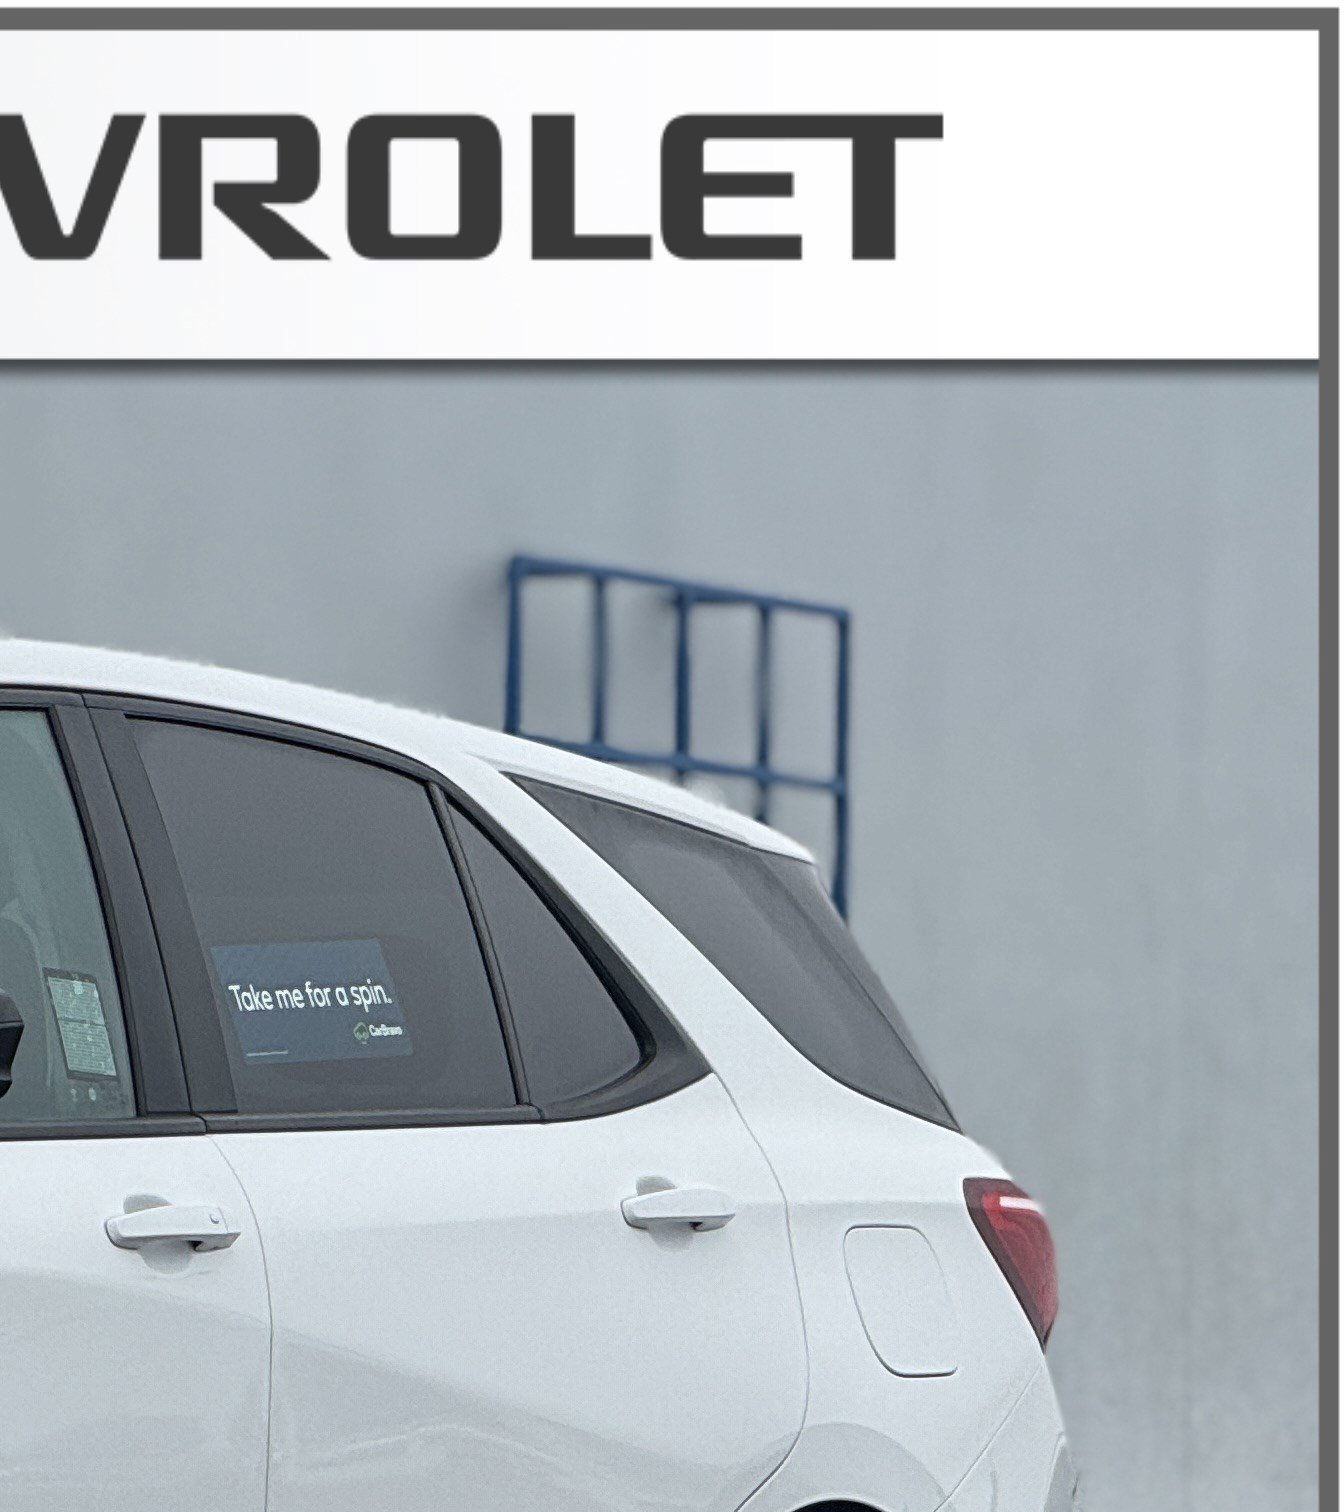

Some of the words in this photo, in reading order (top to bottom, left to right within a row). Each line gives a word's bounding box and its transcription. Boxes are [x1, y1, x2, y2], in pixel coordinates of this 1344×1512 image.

[228, 984, 273, 1012] Take
[275, 989, 303, 1008] me
[305, 981, 331, 1008] for
[335, 988, 349, 1005] a
[351, 979, 392, 1012] spin.
